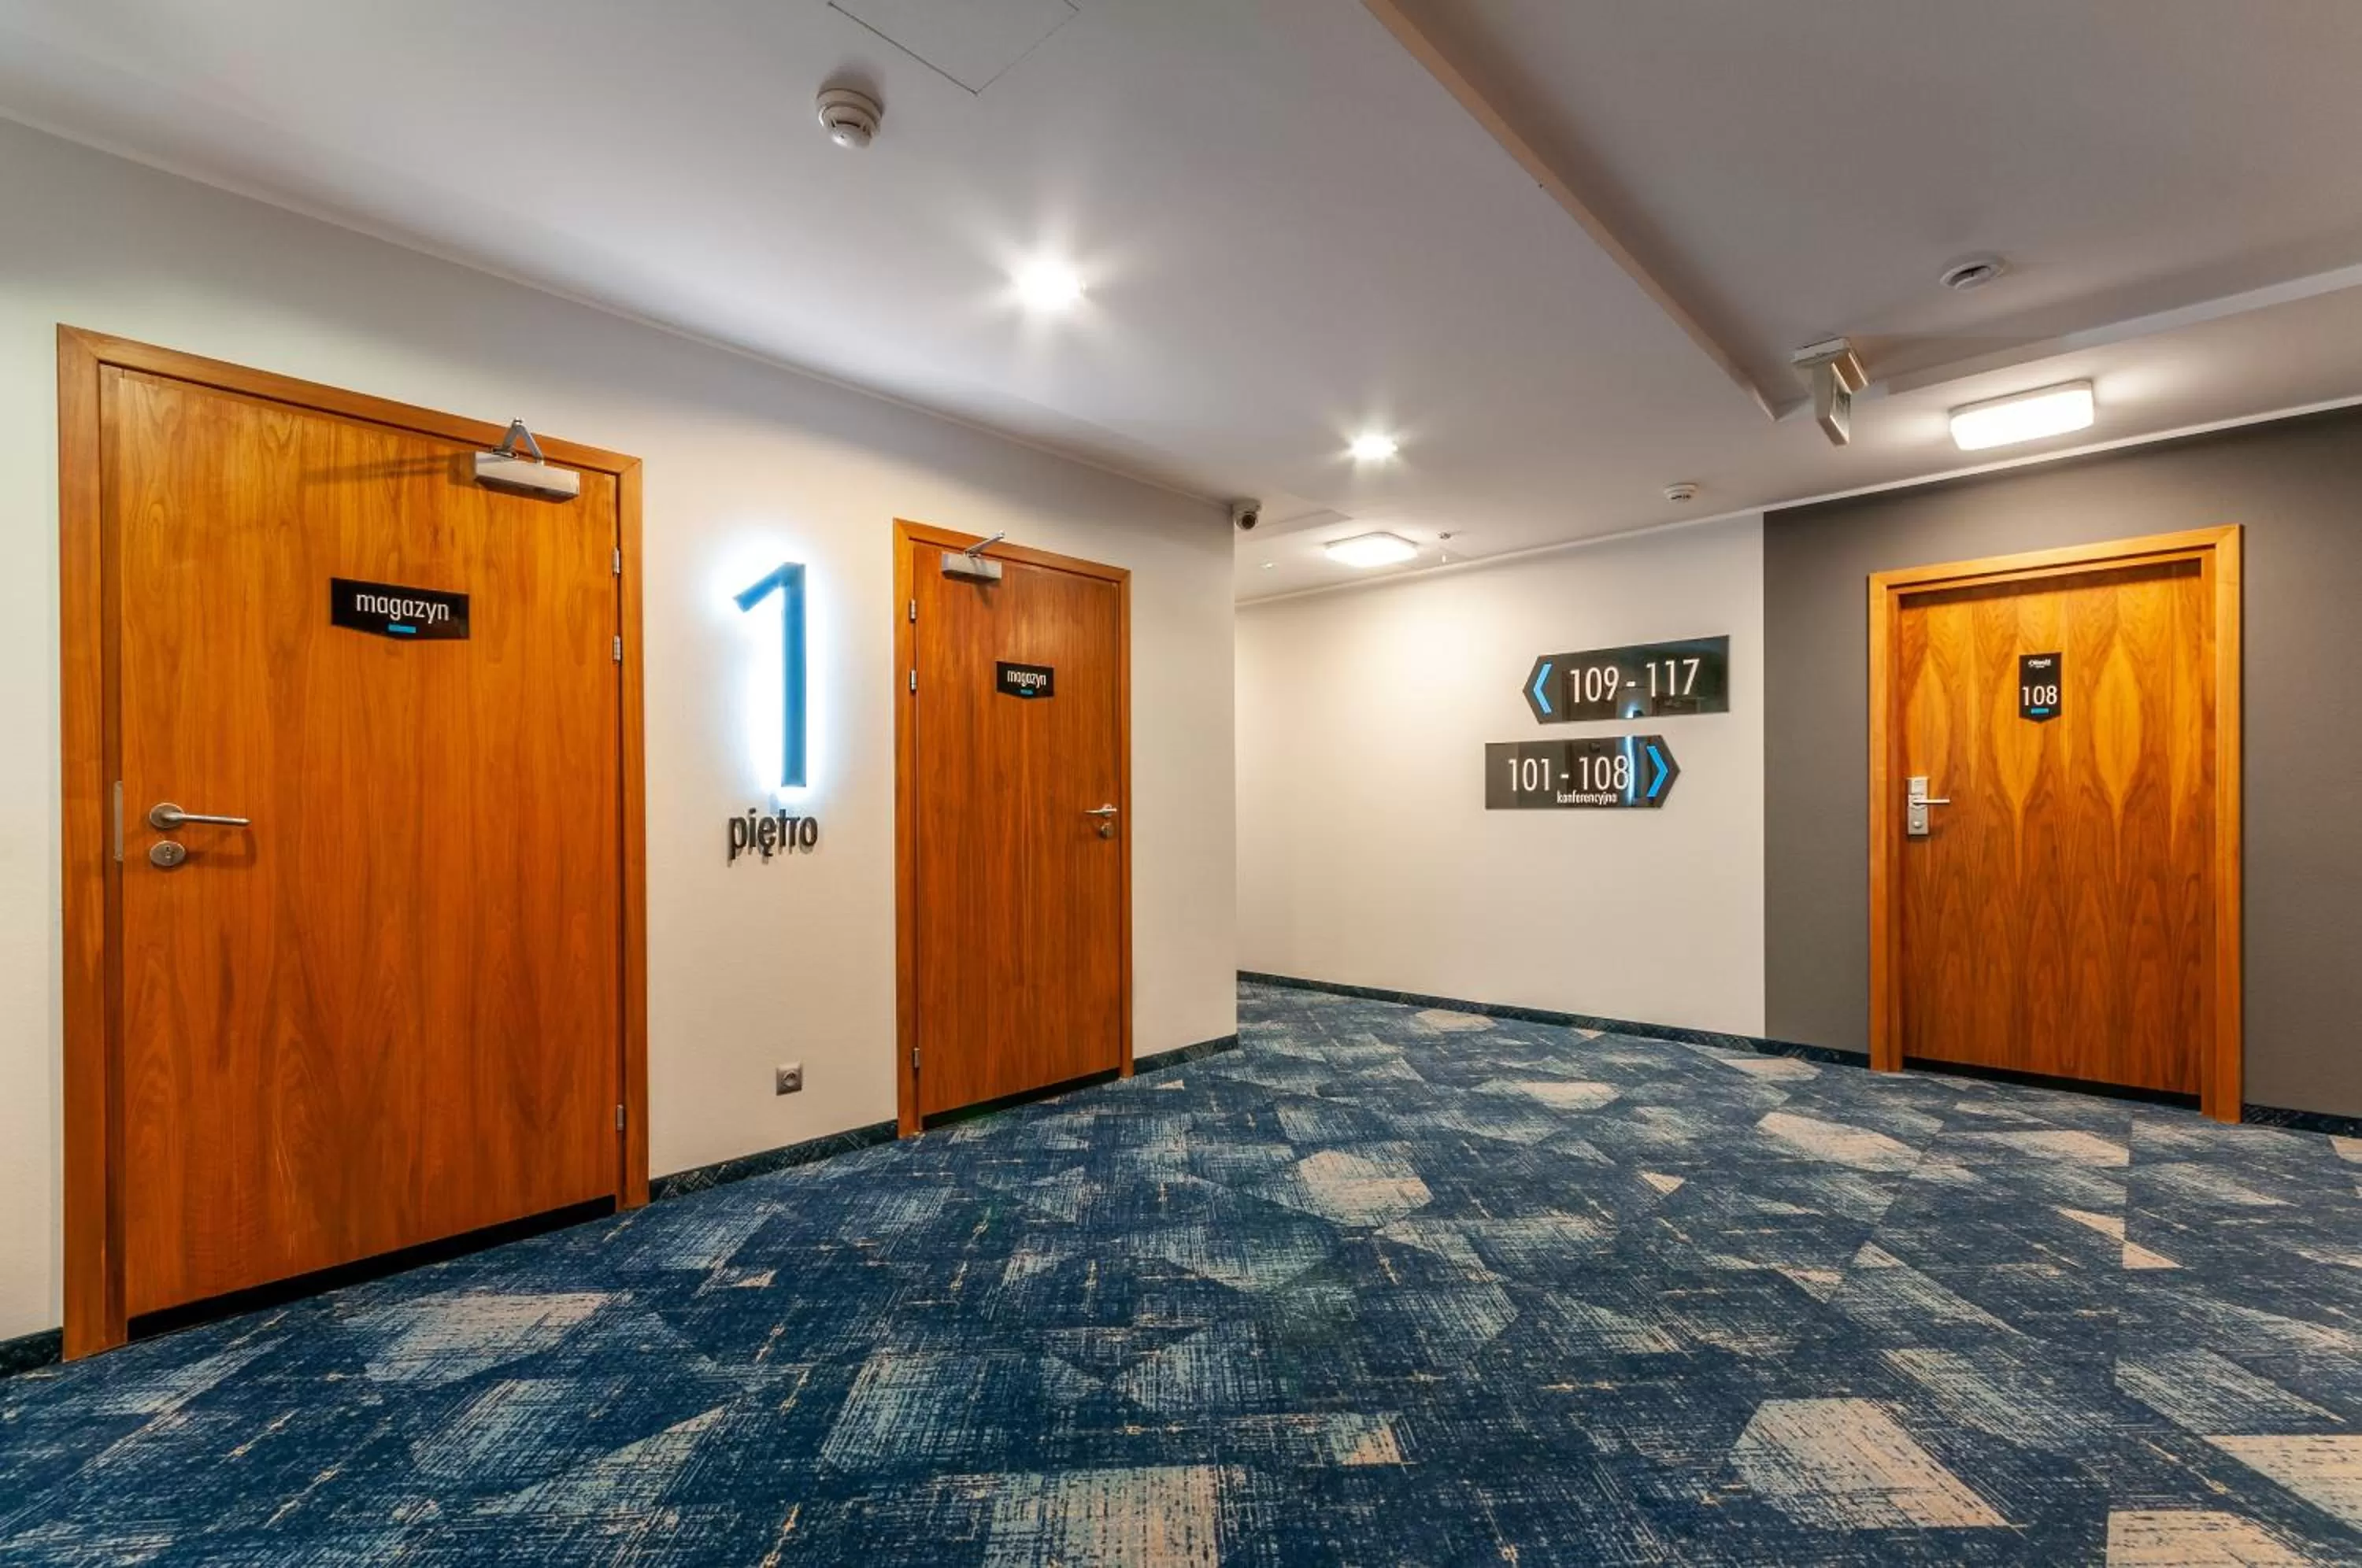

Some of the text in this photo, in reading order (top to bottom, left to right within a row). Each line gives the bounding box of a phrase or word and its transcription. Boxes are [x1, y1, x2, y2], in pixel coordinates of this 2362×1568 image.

[356, 594, 450, 624] magazyn
[733, 562, 806, 787] 1
[1007, 670, 1046, 689] magazyn
[1569, 666, 1620, 703] 109
[1646, 658, 1700, 697] 117
[2022, 685, 2057, 706] 108
[1509, 758, 1550, 792] 101
[1579, 755, 1630, 791] 108
[728, 808, 818, 860] piętro
